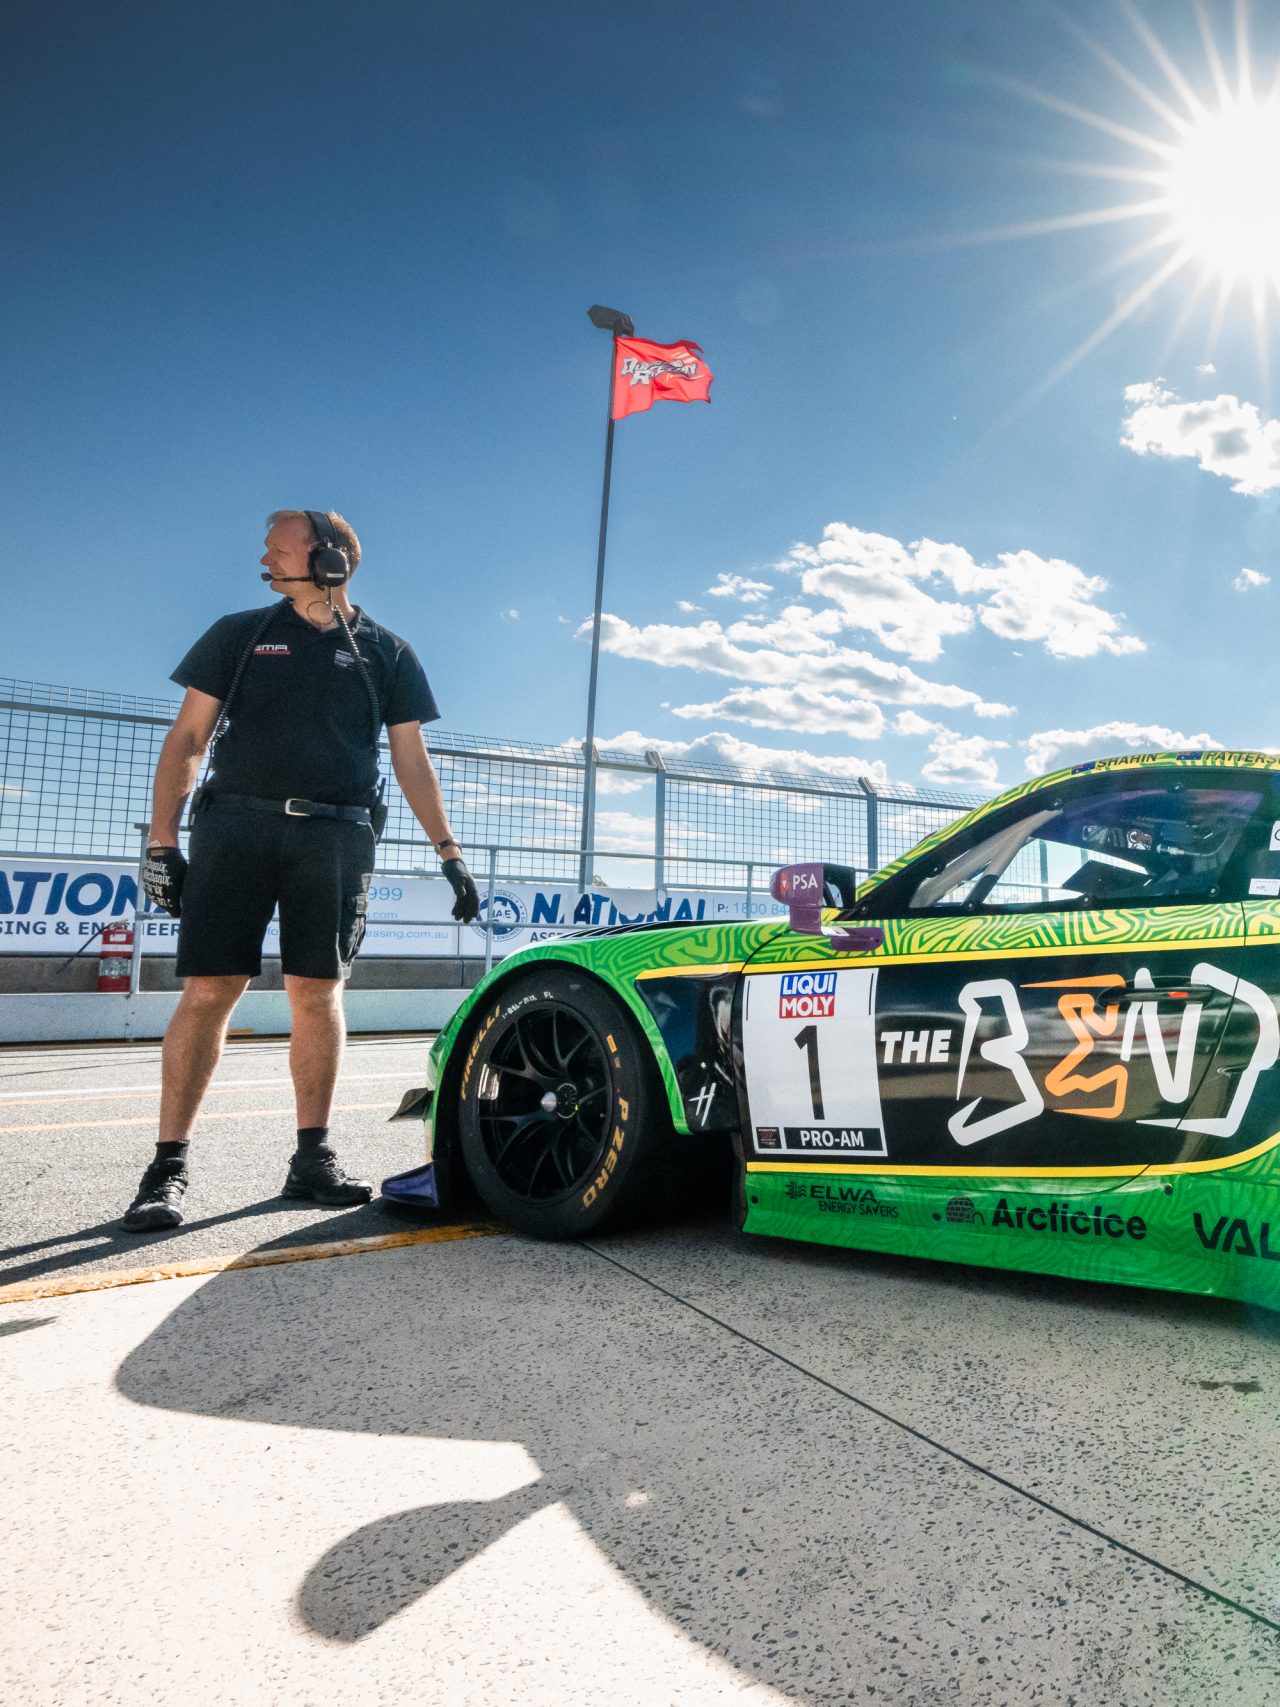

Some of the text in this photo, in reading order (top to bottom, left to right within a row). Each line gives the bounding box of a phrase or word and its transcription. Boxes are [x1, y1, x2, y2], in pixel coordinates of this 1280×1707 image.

[1097, 753, 1158, 768] SHAHIN
[793, 874, 818, 890] PSA
[717, 902, 729, 913] P:
[734, 902, 765, 915] 1800
[55, 921, 69, 935] &
[783, 974, 835, 995] LIQUI
[782, 996, 834, 1017] MOLY
[461, 1004, 500, 1100] PIRELLI
[880, 1029, 952, 1064] THE
[794, 1025, 825, 1120] 1
[801, 1130, 865, 1148] PRO-AM
[810, 1185, 878, 1203] ELWA
[819, 1201, 899, 1218] ENERGY SAVERS
[991, 1197, 1147, 1240] ArcticIce
